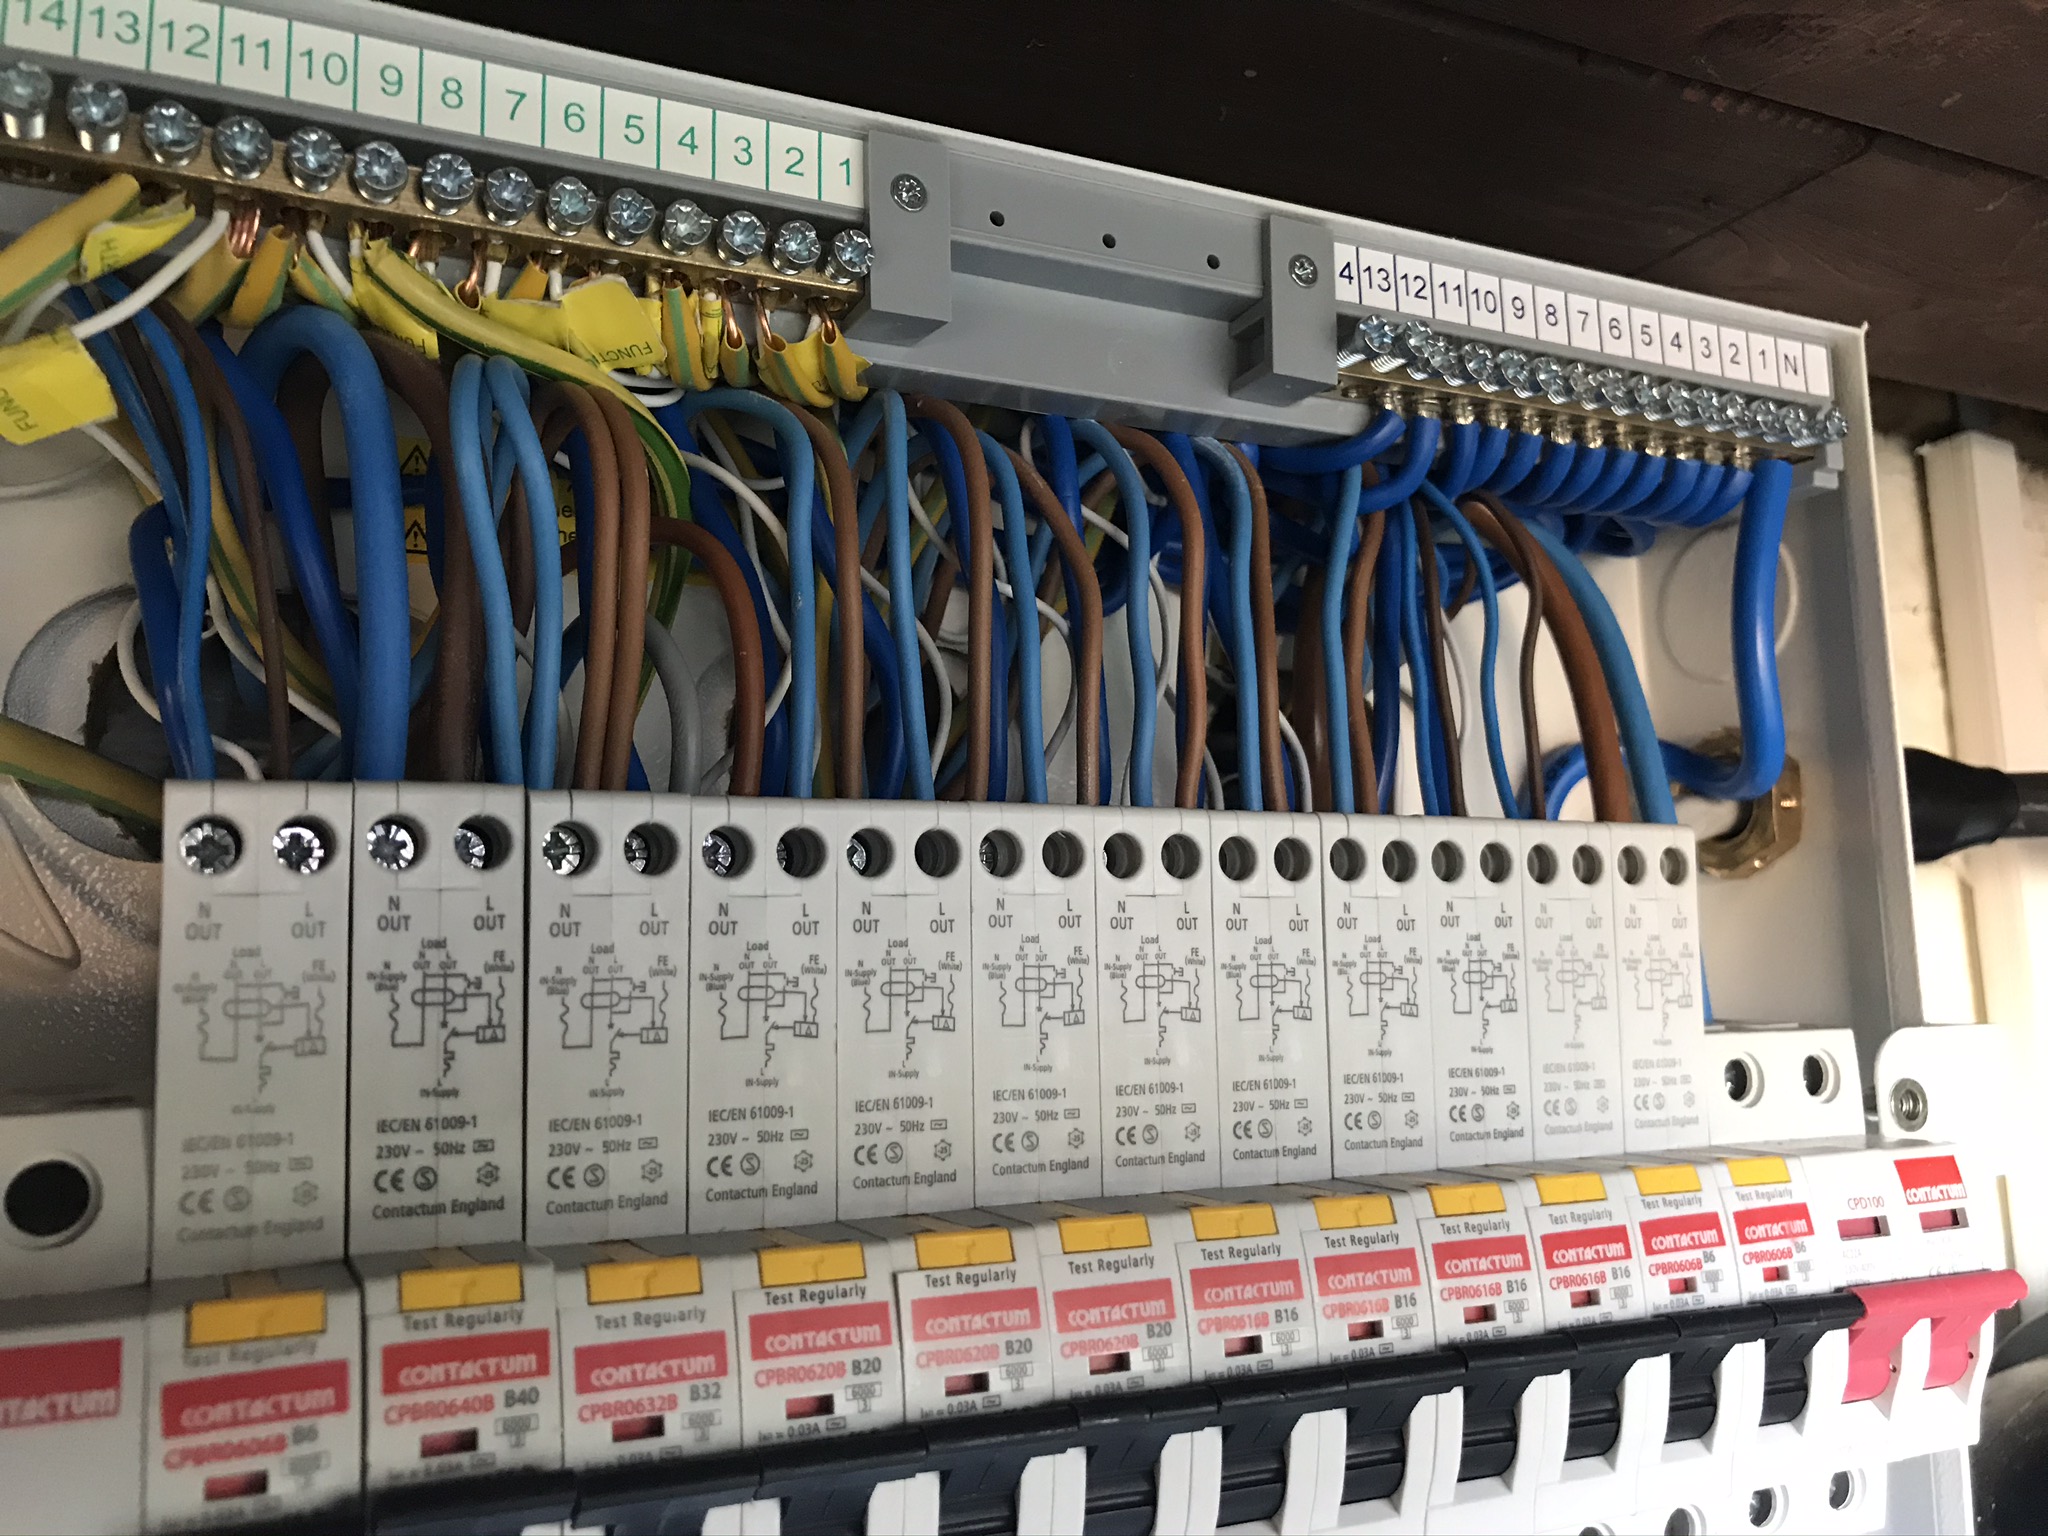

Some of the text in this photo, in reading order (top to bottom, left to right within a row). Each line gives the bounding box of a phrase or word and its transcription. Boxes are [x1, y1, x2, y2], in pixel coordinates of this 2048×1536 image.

[16, 0, 851, 186] 14 13 12 11 10 9 8 7 6 5 4 3 2 1
[1338, 262, 1798, 375] 4 13 12 11 10 9 8 7 6 5 4 3 2 1 N
[708, 920, 738, 936] OUT
[792, 920, 819, 936] OUT
[853, 919, 879, 933] OUT
[930, 919, 955, 933] OUT
[989, 915, 1013, 928] OUT
[1059, 915, 1081, 928] OUT
[1110, 917, 1133, 930] OUT
[1177, 918, 1198, 930] OUT
[1226, 918, 1248, 930] OUT
[1289, 919, 1309, 932] OUT
[888, 938, 908, 948] Load
[1021, 934, 1039, 943] Load
[945, 952, 955, 961] FE
[1074, 946, 1083, 955] FE
[1344, 1072, 1403, 1084] IEC/EN 61009-1
[1448, 1066, 1505, 1078] IEC/EN 61009-1
[1116, 1082, 1183, 1096] IEC/EN 61009-1
[1233, 1078, 1296, 1092] IEC/EN 61009-1
[1449, 1085, 1499, 1098] 230V 50Hz
[993, 1088, 1067, 1102] IEC/EN 61009-1
[1344, 1092, 1397, 1104] 230V 50Hz
[855, 1096, 933, 1112] IEC/EN 61009-1
[1116, 1104, 1176, 1117] 230V 50Hz
[708, 1105, 794, 1122] IEC/EN 61009-1
[993, 1109, 1059, 1124] 230V 50Hz
[855, 1120, 925, 1135] 230V 50Hz
[1450, 1126, 1523, 1142] Contactum England
[708, 1130, 784, 1146] 230V 50Hz
[1344, 1136, 1422, 1151] Contactum England
[1116, 1150, 1204, 1168] Contactum England
[1233, 1144, 1316, 1161] Contactum England
[992, 1156, 1089, 1176] Contactum England
[853, 1170, 956, 1189] Contactum England
[706, 1182, 818, 1202] Contactum England
[1736, 1187, 1792, 1200] Test Regularly
[1906, 1183, 1967, 1204] CONTACTUM
[372, 1198, 505, 1219] Contactum England
[546, 1192, 668, 1215] Contactum England
[1642, 1194, 1702, 1210] Test Regularly
[1848, 1196, 1884, 1210] CPD100
[1549, 1208, 1612, 1224] Test Regularly
[1441, 1218, 1510, 1234] Test Regularly
[1744, 1219, 1808, 1240] CONTACTUM
[1324, 1230, 1399, 1248] Test Regularly
[1651, 1228, 1719, 1251] CONTACTUM
[1201, 1242, 1281, 1261] Test Regularly
[1552, 1242, 1626, 1264] CONTACTUM
[1742, 1242, 1806, 1266] CPBR0606B B6
[1068, 1254, 1155, 1274] Test Regularly
[1444, 1252, 1523, 1274] CONTACTUM
[1648, 1250, 1716, 1277] CPBR0606B B6
[925, 1267, 1016, 1287] Test Regularly
[1328, 1267, 1412, 1290] CONTACTUM
[1549, 1266, 1631, 1292] CPBR0616B B16
[765, 1284, 867, 1305] Test Regularly
[1204, 1281, 1294, 1303] CONTACTUM
[1440, 1278, 1528, 1302] CPBR0616B B16
[1395, 1294, 1416, 1308] B16
[402, 1306, 524, 1332] Test Regularly
[595, 1306, 707, 1330] Test Regularly
[924, 1309, 1030, 1335] CONTACTUM
[1068, 1300, 1166, 1327] CONTACTUM
[1275, 1309, 1299, 1323] B16
[765, 1324, 880, 1352] CONTACTUM
[1060, 1322, 1172, 1359] CPBR0620B B20
[1275, 1332, 1295, 1343] 6000
[916, 1338, 1032, 1369] CPBR0620B B20
[399, 1353, 536, 1387] CONTACTUM
[590, 1356, 716, 1386] CONTACTUM
[754, 1358, 881, 1388] CPBR0620B B20
[504, 1387, 539, 1408] B40
[577, 1383, 721, 1423] CPBR0632B B32
[180, 1389, 336, 1428] CONTACTUM
